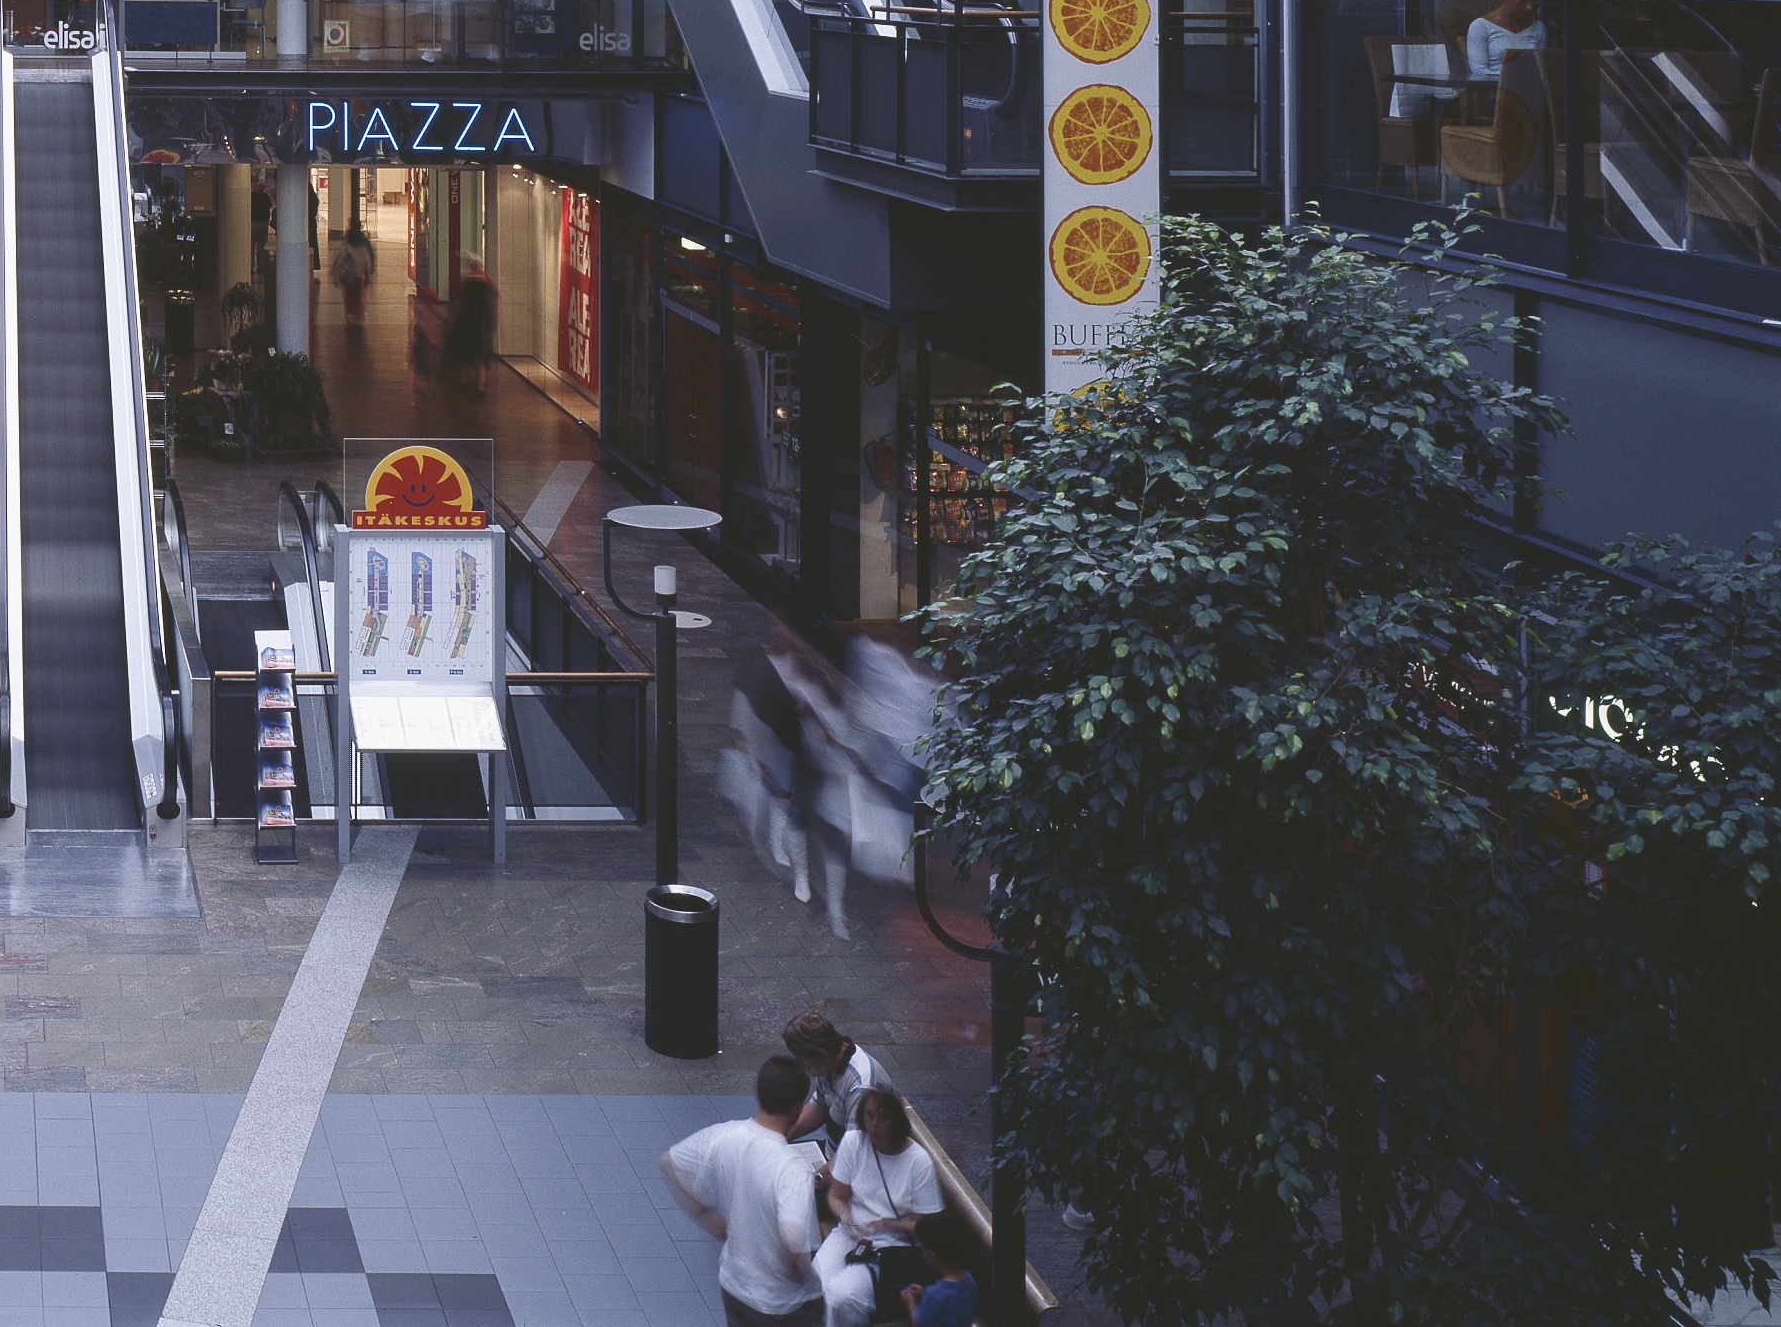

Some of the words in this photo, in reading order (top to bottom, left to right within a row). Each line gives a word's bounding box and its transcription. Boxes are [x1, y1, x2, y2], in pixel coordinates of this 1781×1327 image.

[43, 20, 95, 49] elisa
[579, 22, 631, 52] elisa
[308, 101, 536, 152] PIAZZA
[567, 286, 591, 337] ALE
[567, 328, 591, 383] REA
[356, 513, 482, 526] ITÄKESKUS
